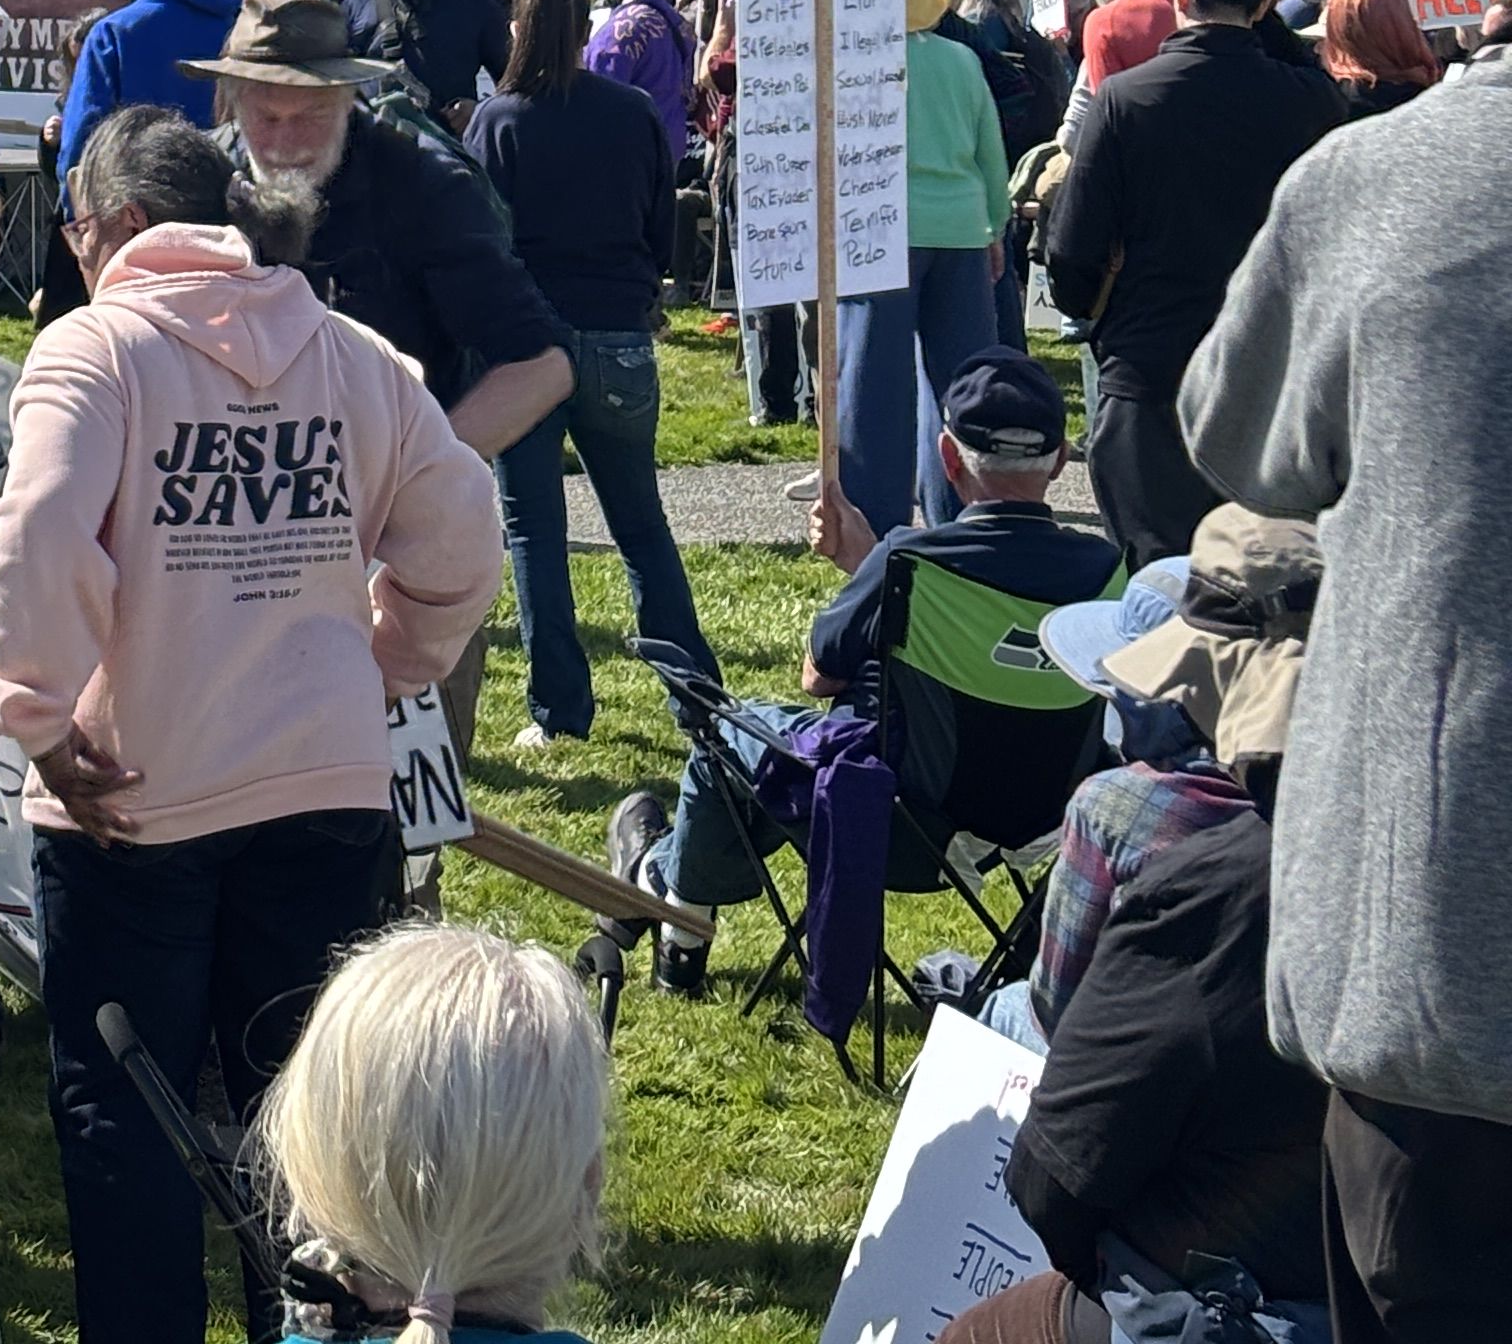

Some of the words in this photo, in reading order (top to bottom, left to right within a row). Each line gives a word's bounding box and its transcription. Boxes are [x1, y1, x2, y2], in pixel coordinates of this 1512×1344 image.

[743, 184, 767, 211] Tax
[749, 252, 806, 282] Stupid
[842, 238, 886, 267] Pedo
[232, 590, 267, 603] JOHN
[952, 1239, 1026, 1300] EOPLE
